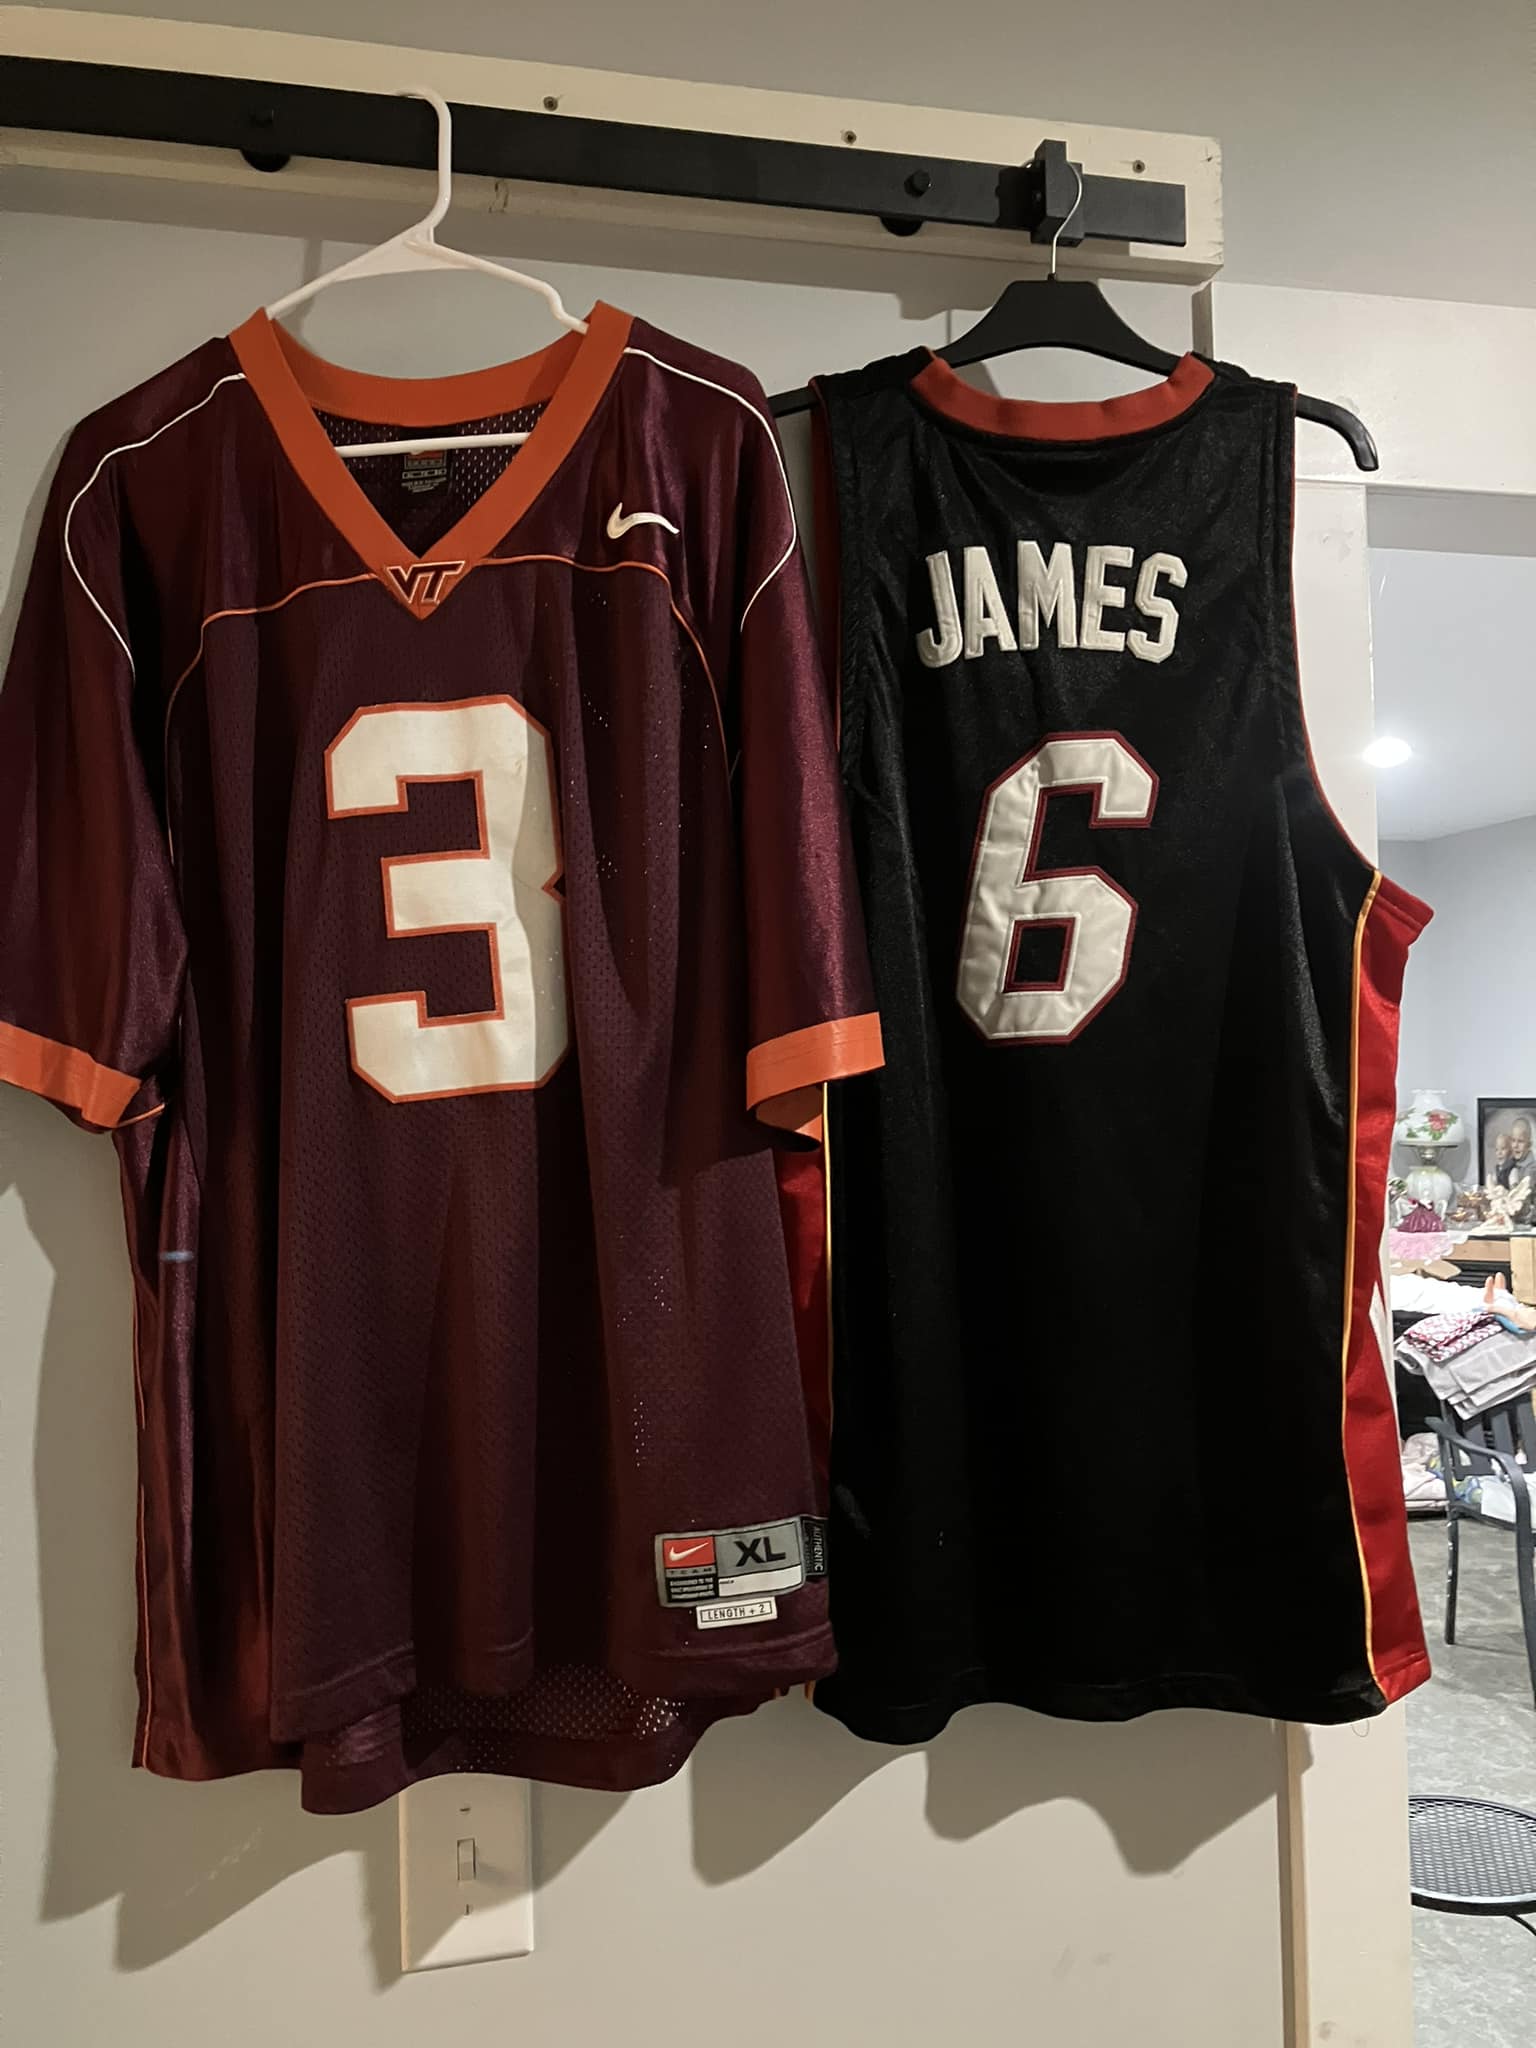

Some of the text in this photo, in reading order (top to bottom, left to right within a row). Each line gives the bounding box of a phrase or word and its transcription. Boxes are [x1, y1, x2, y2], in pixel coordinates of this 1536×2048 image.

[386, 560, 466, 604] VT
[916, 539, 1188, 669] JAMES
[323, 694, 571, 1104] 3
[955, 730, 1160, 1046] 6
[734, 1536, 786, 1567] XL
[813, 1526, 824, 1572] AUTHENTIC
[707, 1608, 746, 1620] LENGTH
[758, 1604, 765, 1613] 2
